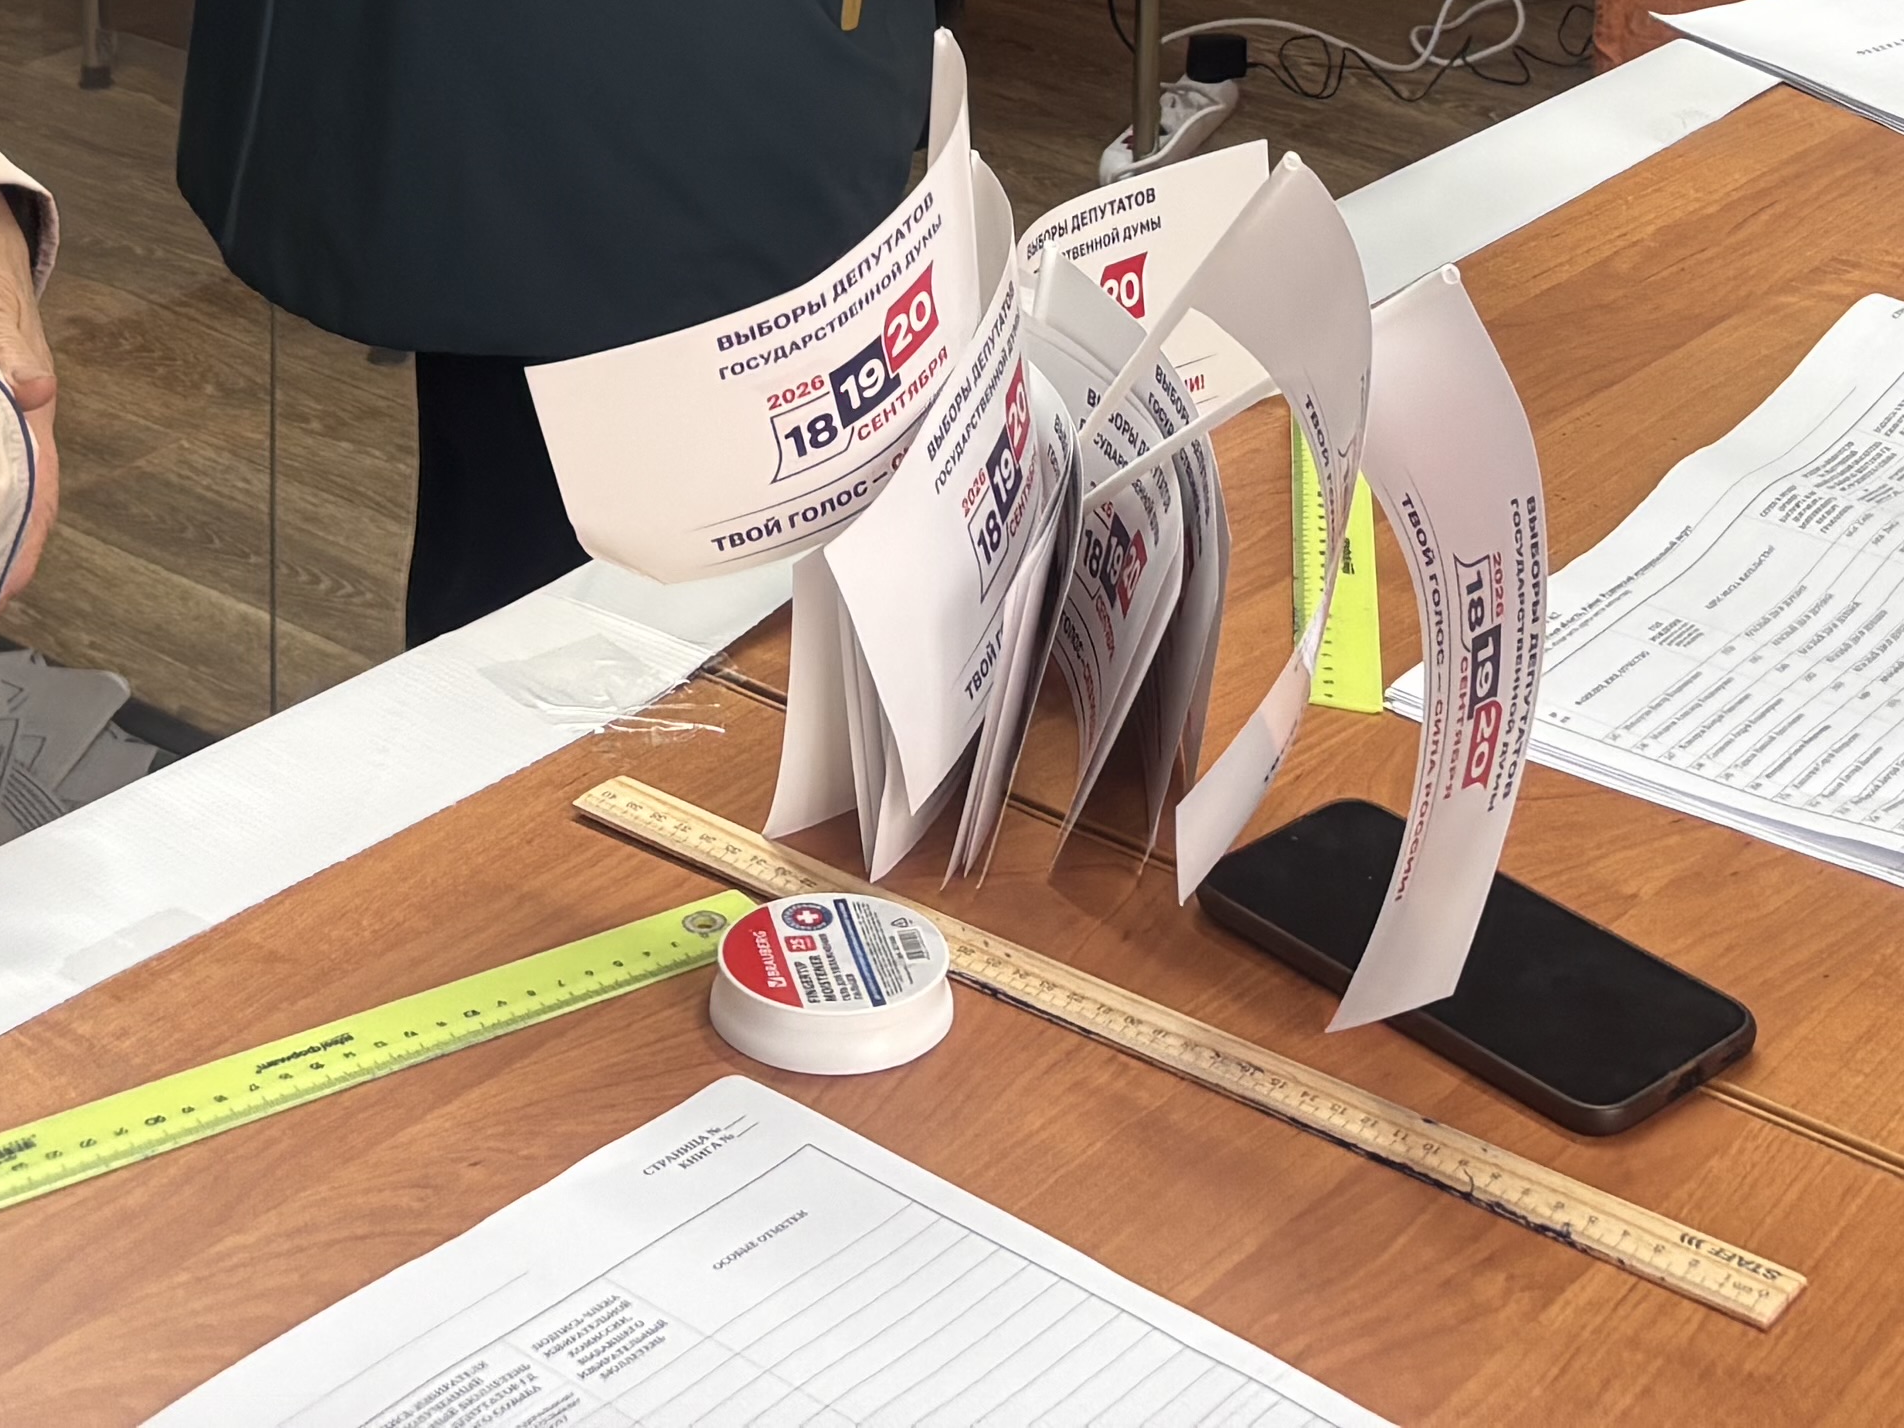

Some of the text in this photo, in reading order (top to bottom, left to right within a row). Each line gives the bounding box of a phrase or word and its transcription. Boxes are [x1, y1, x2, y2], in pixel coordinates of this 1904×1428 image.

[1027, 187, 1156, 261] ВЫБОРЫ ДЕПУТАТОВ
[1122, 215, 1162, 243] ДУМЫ
[717, 191, 935, 352] ВЫБОРЫ ДЕПУТАТОВ
[719, 214, 943, 381] ГОСУДАРСТВЕННОЙ ДУМЫ
[767, 374, 825, 411] 2026
[783, 290, 932, 458] 18 19 20
[857, 345, 949, 442] СЕНТЯБРЯ
[926, 280, 1015, 462] ВЫБОРЫ ДЕПУТАТОВ
[1154, 363, 1190, 425] ВЫБОР
[934, 349, 1008, 495] ГОСУДАРСТВЕННОЙ
[961, 467, 987, 518] 2026
[974, 387, 1028, 565] 18 19 20
[711, 480, 869, 553] ТВОЙ ГОЛОС
[1082, 528, 1141, 600] 18 19 20
[1493, 551, 1505, 619] 2026
[964, 645, 998, 701] ТВОЙ
[1465, 569, 1496, 779] 18 19 20
[1487, 498, 1525, 813] ГОСУДАРСТВЕННОЙ ДУМЫ
[1502, 495, 1542, 800] ВЫБОРЫ ДЕПУТАТОВ
[1395, 492, 1446, 903] ТВОЙ ГОЛОС СИЛА РОССИИ!
[1443, 655, 1470, 801] СЕНТЯБРЯ
[752, 930, 778, 980] BRAUBERG
[789, 937, 807, 951] 25
[809, 954, 837, 1002] MOISTENER
[794, 961, 821, 1004] FINGERTIP
[642, 1125, 724, 1178] СТРАНИЦА №
[678, 1132, 736, 1172] КНИГА №
[712, 1209, 809, 1271] ОСОБЫЕ ОТМЕТКИ
[1708, 1247, 1783, 1282] STAFF
